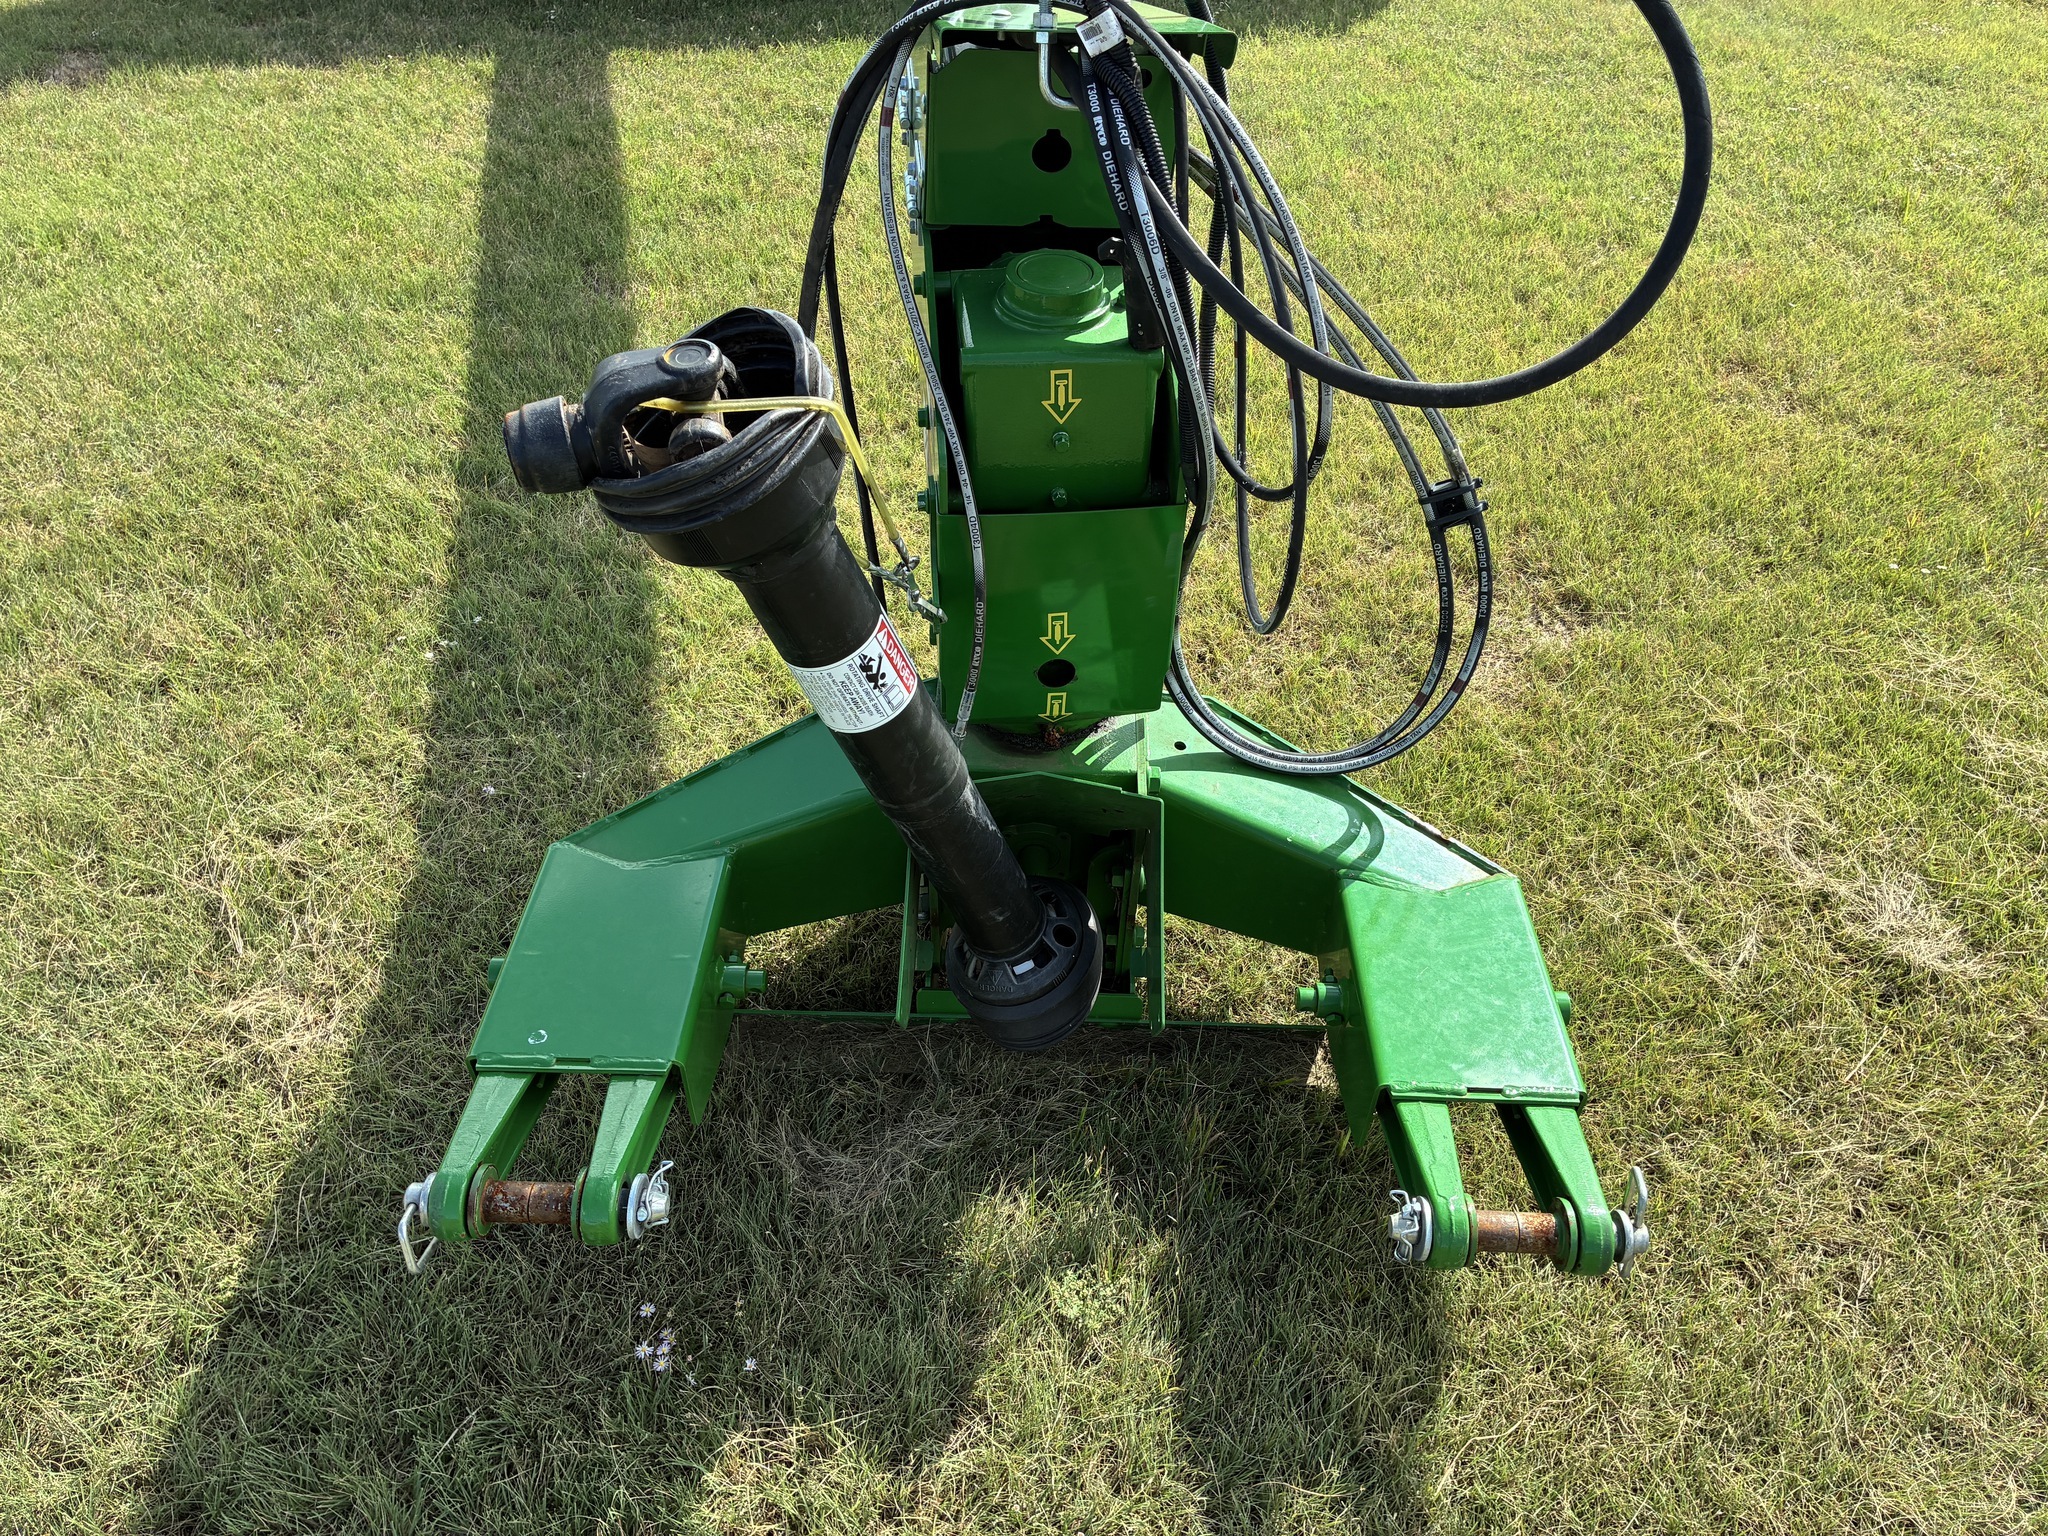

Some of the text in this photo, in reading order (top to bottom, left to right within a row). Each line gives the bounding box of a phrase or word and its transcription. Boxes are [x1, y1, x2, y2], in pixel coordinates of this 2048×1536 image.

[891, 12, 914, 33] T3000
[1086, 83, 1100, 113] T3000
[1209, 90, 1220, 106] PSI
[1220, 107, 1237, 129] MSHA
[1256, 162, 1271, 182] FRAS
[1272, 191, 1297, 236] ABRASION
[1292, 234, 1314, 283] RESISTANT
[884, 191, 896, 234] RESISTANT
[1140, 211, 1161, 255] T3006D
[890, 235, 904, 275] ABRASION
[902, 281, 912, 304] FRAS
[1332, 291, 1346, 307] FRAS
[1169, 301, 1181, 322] DN10
[1176, 325, 1188, 344] MAX
[1330, 337, 1343, 352] MSHA
[1365, 328, 1378, 343] MSHA
[916, 336, 929, 359] MSHA
[1181, 344, 1191, 356] WP
[925, 360, 934, 374] PSI
[1185, 356, 1194, 368] 215
[931, 374, 942, 392] 3500
[1188, 368, 1199, 383] BAR
[938, 396, 949, 413] BAR
[945, 413, 953, 426] 245
[1379, 409, 1390, 424] MAX
[948, 429, 957, 441] WP
[951, 440, 961, 457] MAX
[957, 460, 966, 475] DN6
[1409, 470, 1428, 498] T3006D
[969, 515, 981, 550] T3004D
[1478, 594, 1488, 619] T3000
[885, 641, 916, 690] DANGER
[838, 679, 854, 697] KEEP
[846, 662, 885, 718] ROTATING DRIVE SHAFT
[967, 668, 979, 692] T3000
[830, 678, 839, 687] NOT
[835, 687, 851, 706] OPERATE
[1176, 691, 1194, 715] T3006D
[1258, 758, 1271, 767] BAR
[1344, 759, 1361, 768] FRAS
[1367, 746, 1396, 763] ABRASION
[1396, 727, 1424, 749] RESISTANT
[1323, 750, 1354, 763] ABRASION
[1354, 737, 1383, 754] RESISTANT
